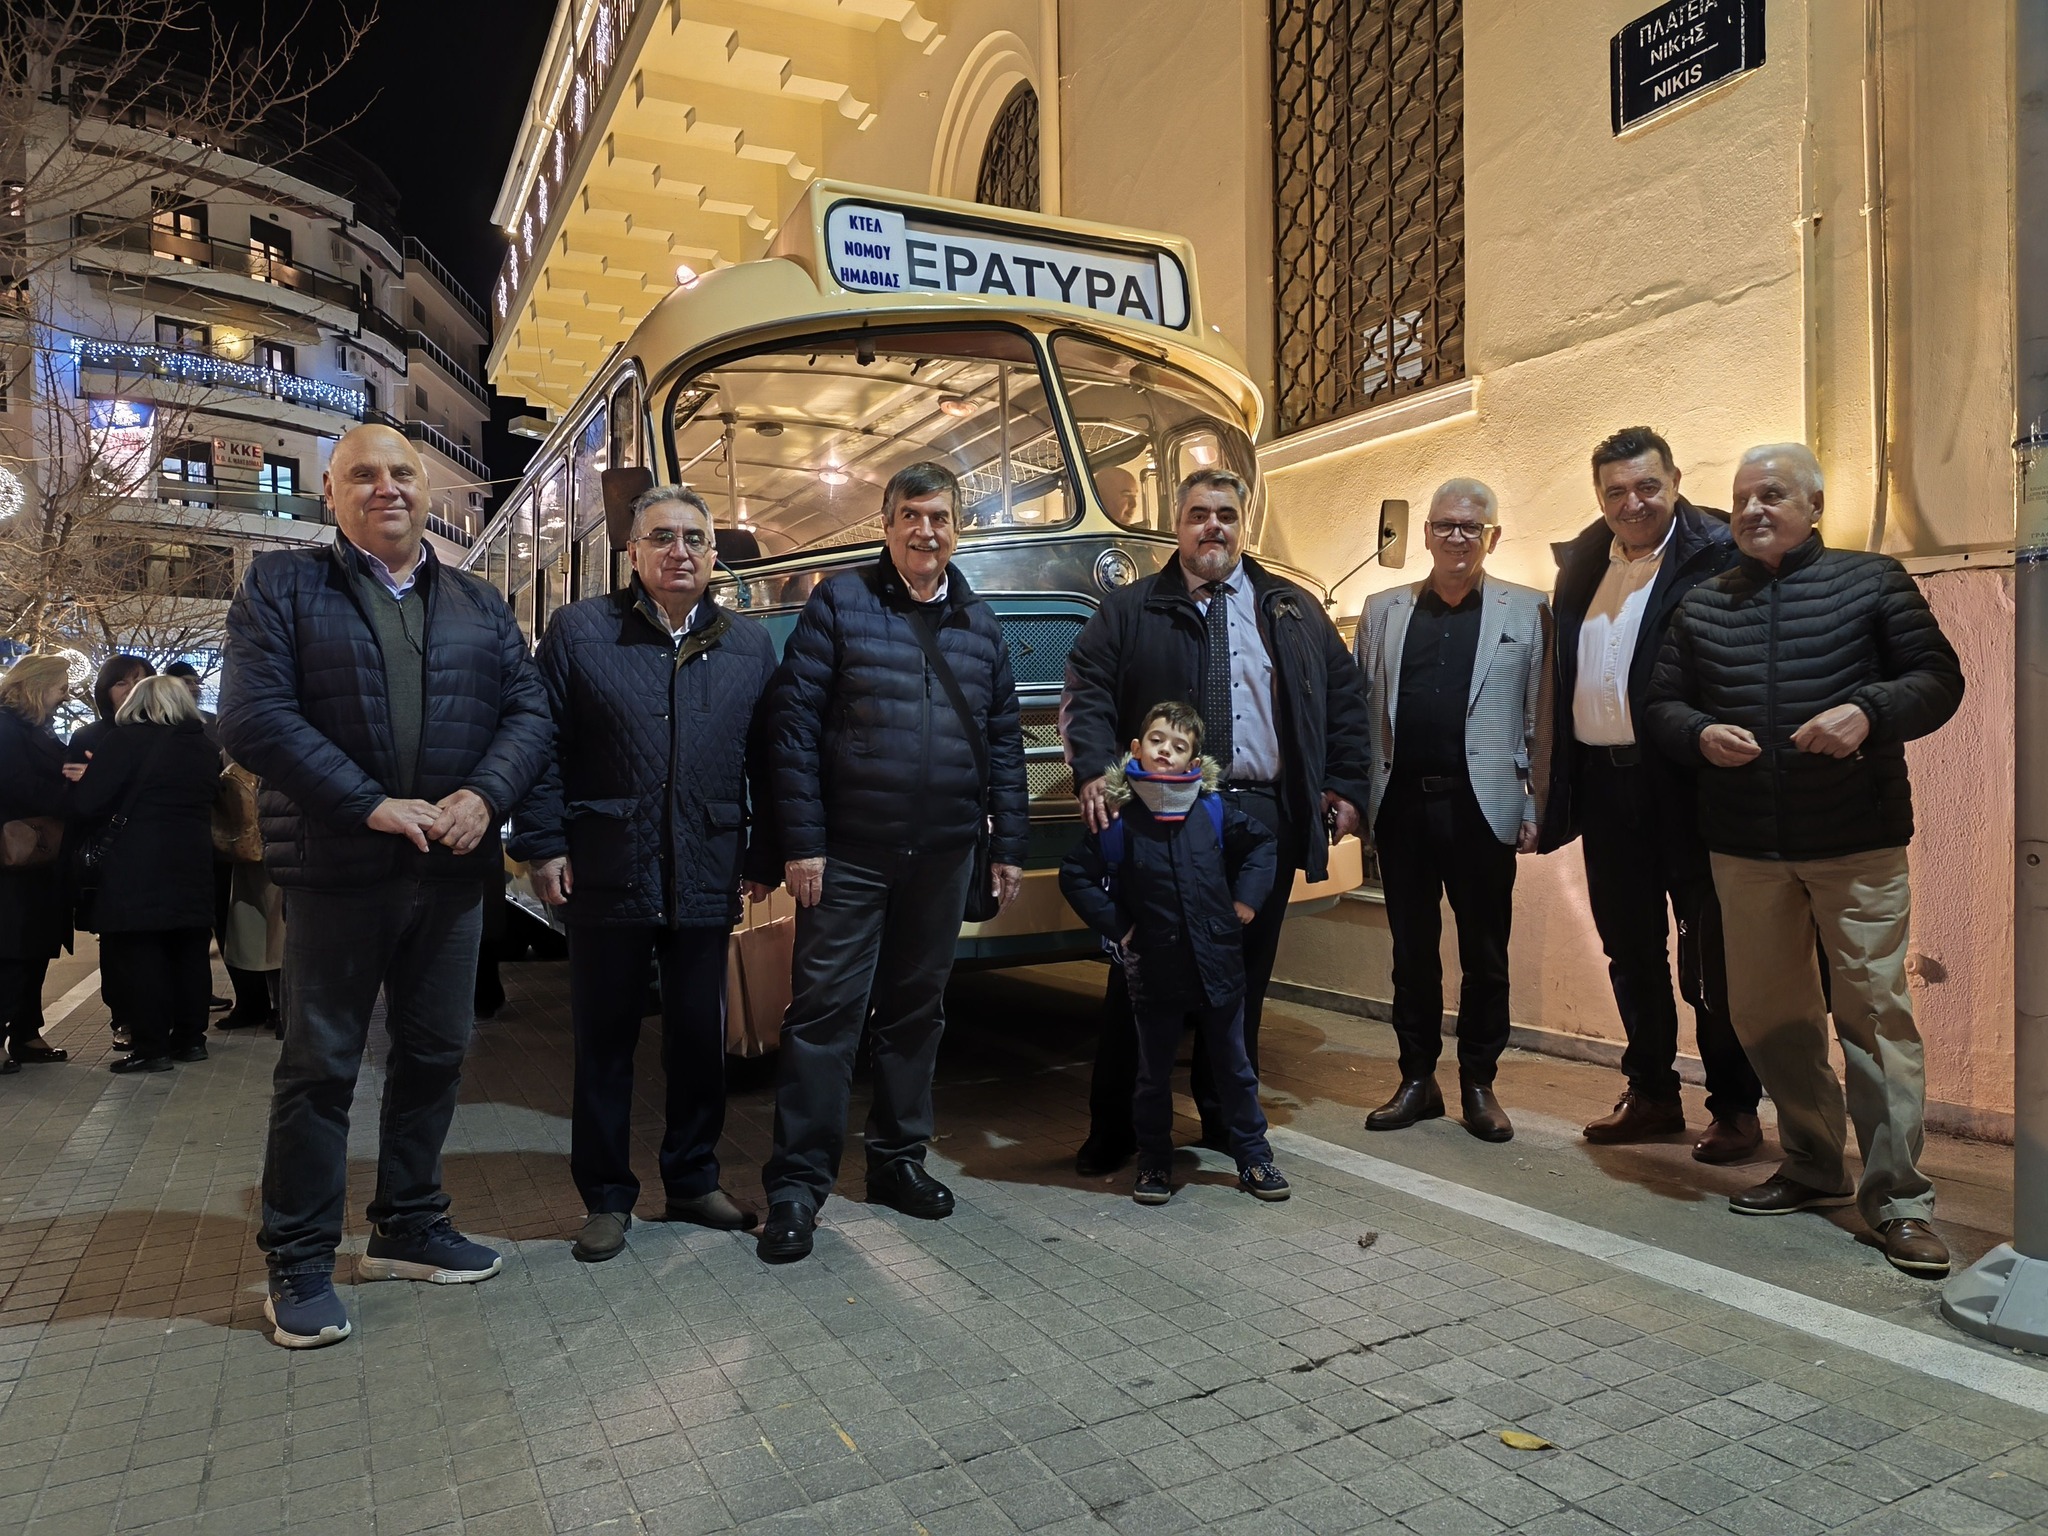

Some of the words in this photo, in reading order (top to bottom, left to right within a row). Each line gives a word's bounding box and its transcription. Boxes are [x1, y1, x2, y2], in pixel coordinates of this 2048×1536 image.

[1640, 0, 1719, 47] ΠΛΑΤΕΙΑ
[1650, 22, 1706, 65] ΝΙΚΗΣ
[1654, 63, 1702, 102] NIKIS
[849, 214, 883, 234] ΚΤΕΛ
[844, 240, 891, 261] ΝΟΜΟΥ
[840, 266, 901, 288] ΗΜΑΘΙΑΣ
[906, 239, 1155, 321] ΕΡΑΤΥΡΑ
[230, 443, 261, 458] ΚΚΕ
